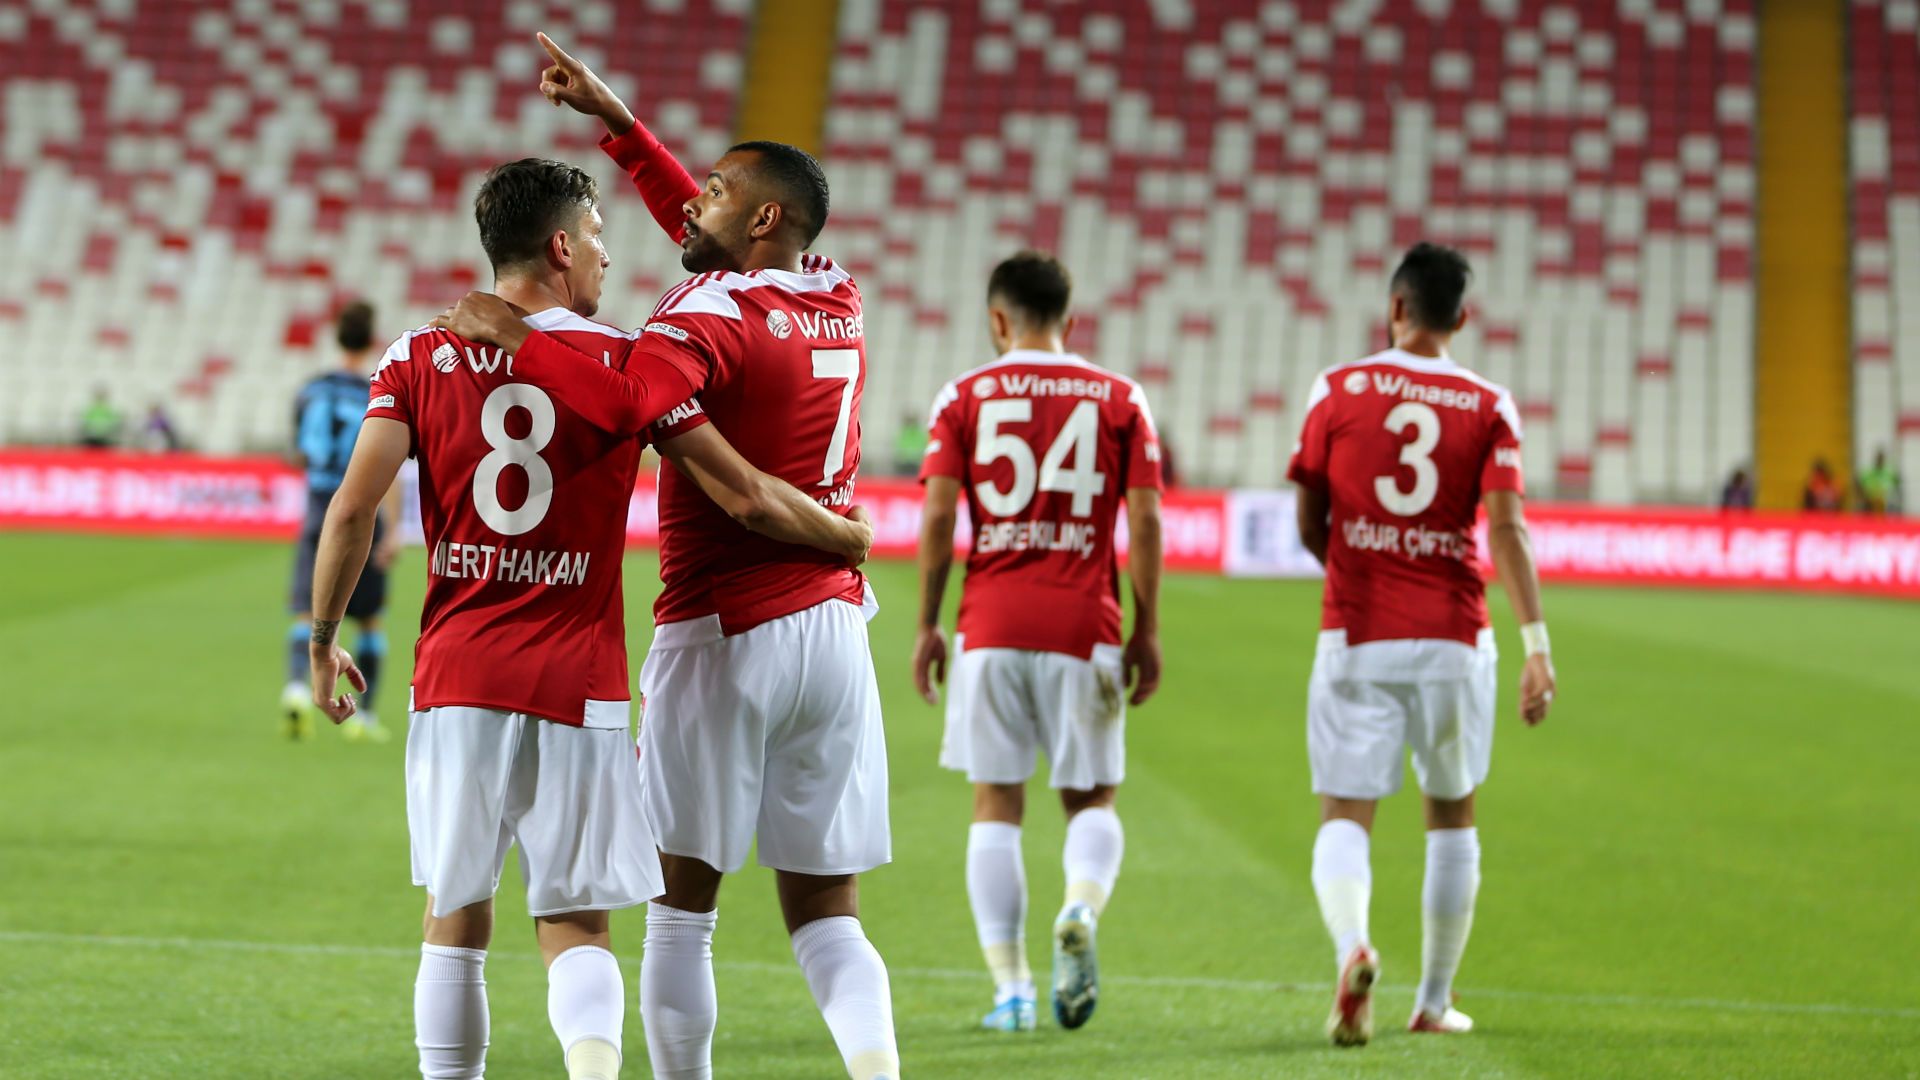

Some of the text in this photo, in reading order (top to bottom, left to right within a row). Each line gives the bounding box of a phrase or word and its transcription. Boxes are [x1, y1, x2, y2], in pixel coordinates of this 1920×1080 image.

[791, 311, 864, 339] Winas
[1000, 374, 1112, 402] Winasol
[1373, 372, 1481, 412] Winasol
[811, 349, 860, 487] 7
[472, 383, 556, 536] 8
[974, 398, 1106, 518] 54
[1374, 401, 1441, 517] 3
[432, 541, 591, 586] MERT HAKAN
[1404, 523, 1469, 561] ÇİFT
